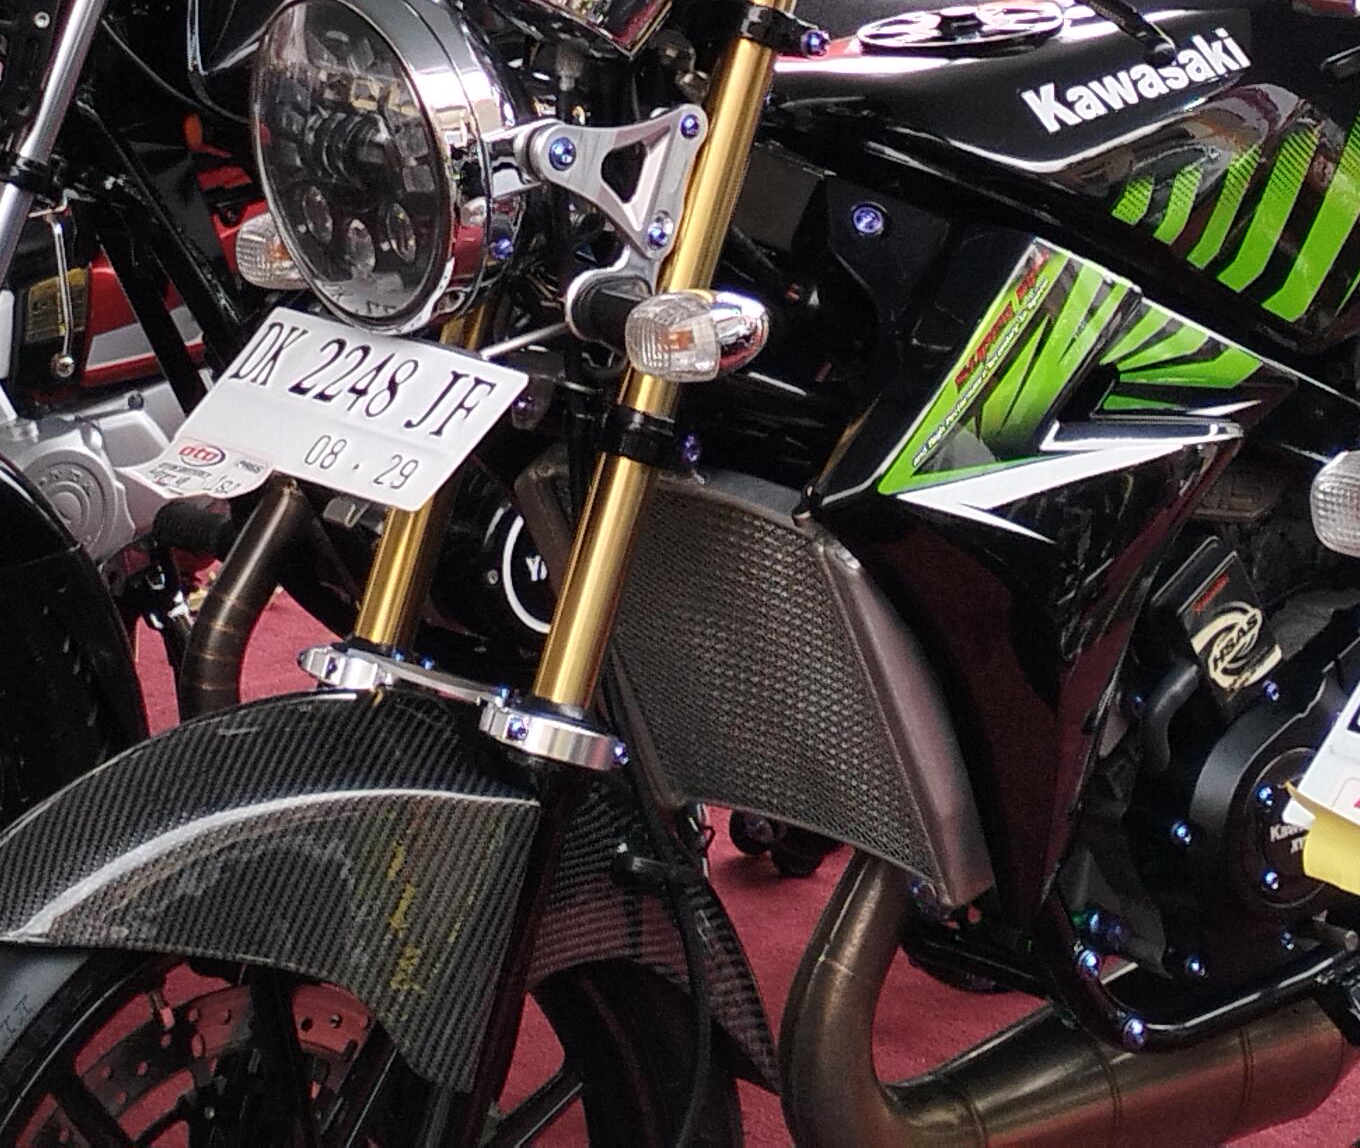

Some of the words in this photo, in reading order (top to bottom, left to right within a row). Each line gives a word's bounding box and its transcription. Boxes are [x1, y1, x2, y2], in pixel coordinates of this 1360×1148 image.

[1020, 27, 1252, 134] Kawasaki
[228, 321, 309, 387] DK
[288, 337, 420, 418] 2248
[403, 370, 497, 437] JF
[303, 434, 348, 470] 08
[372, 454, 419, 490] 29
